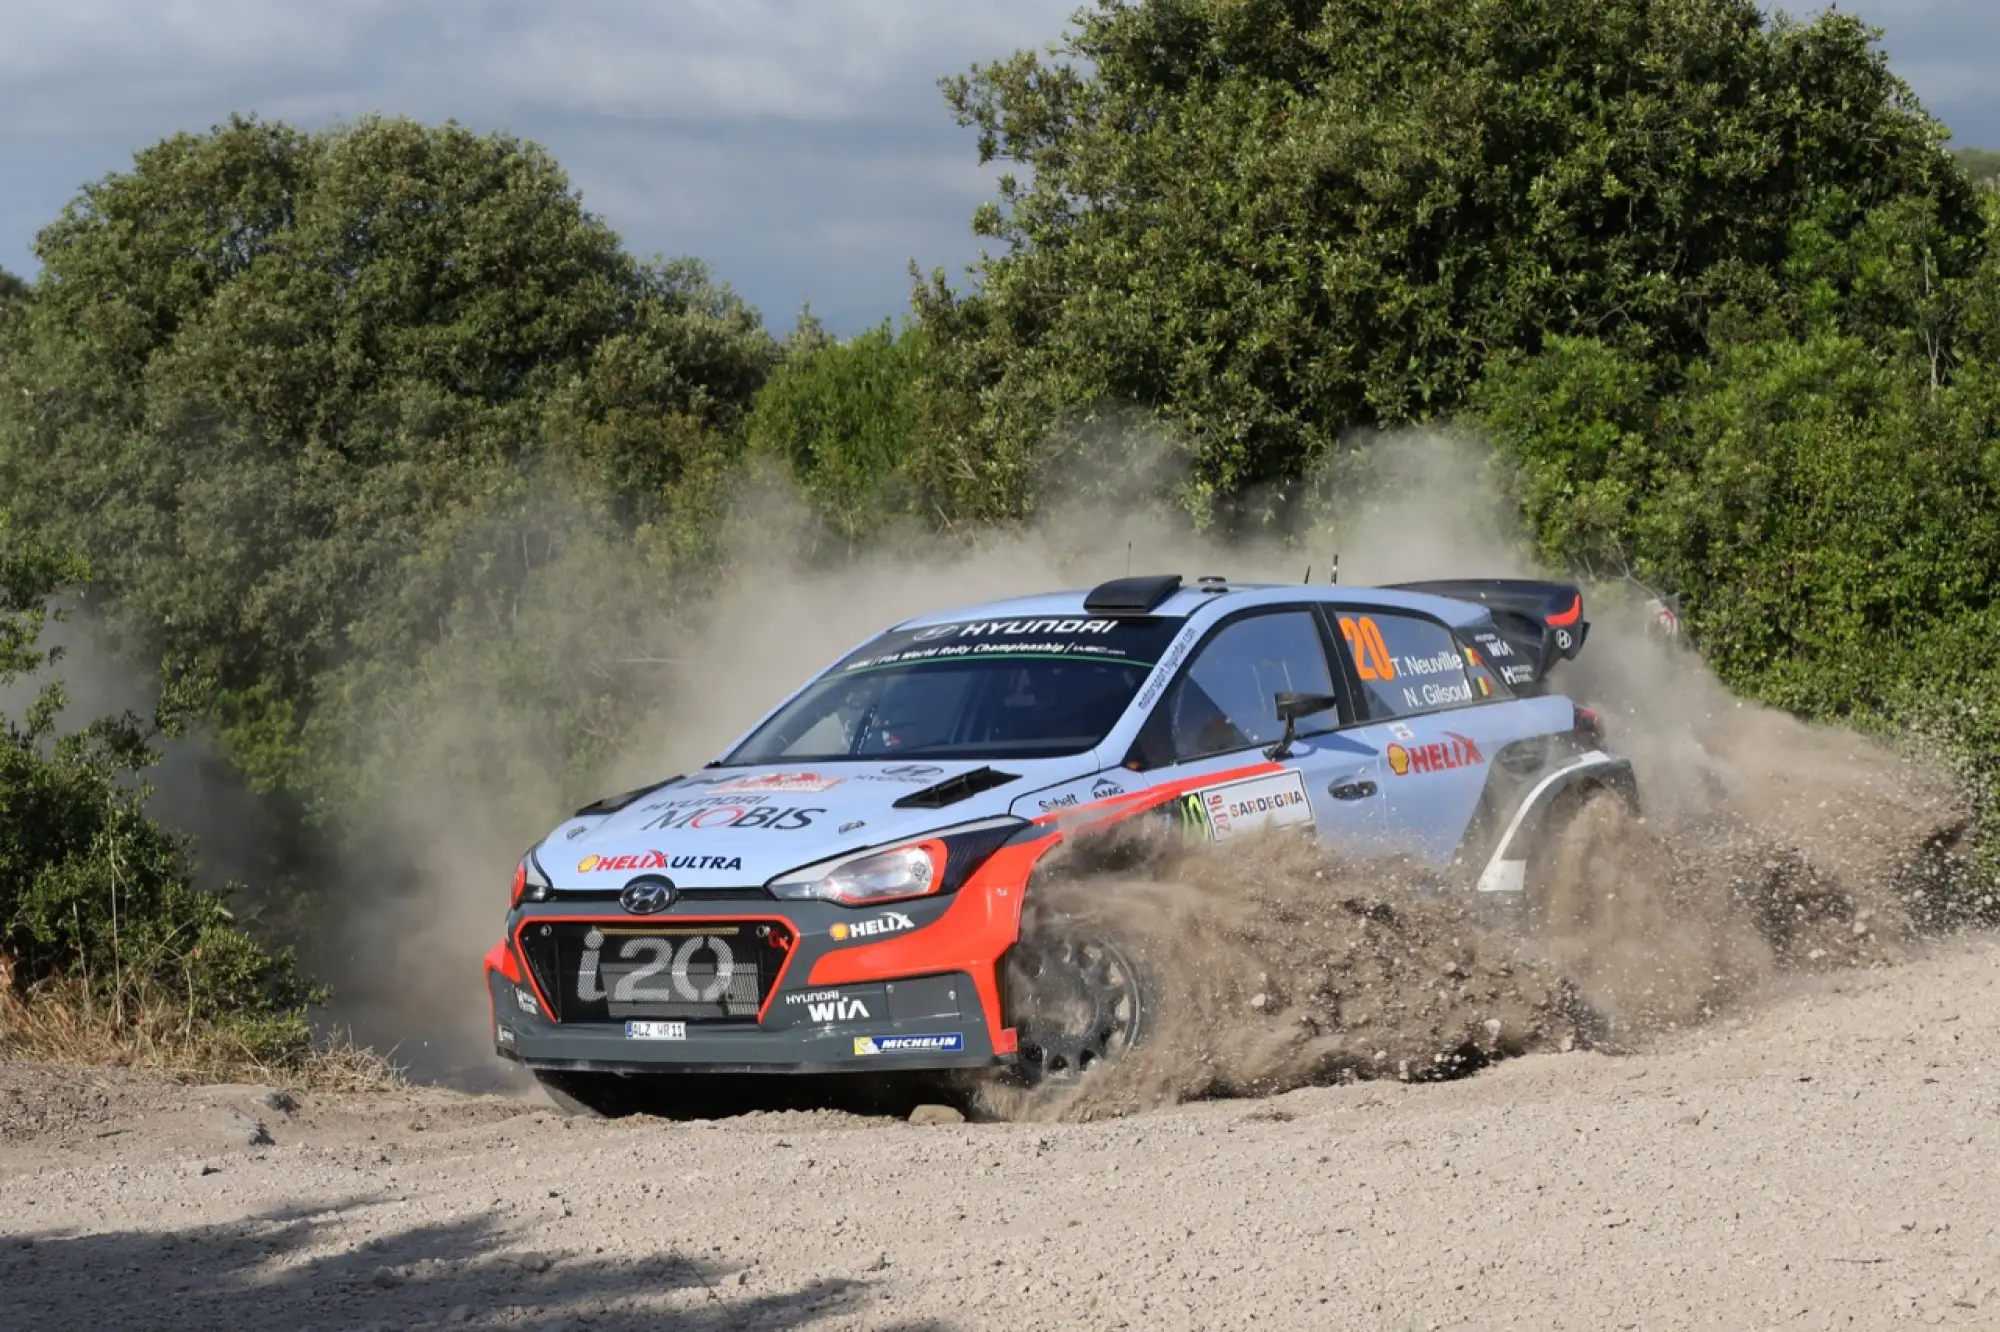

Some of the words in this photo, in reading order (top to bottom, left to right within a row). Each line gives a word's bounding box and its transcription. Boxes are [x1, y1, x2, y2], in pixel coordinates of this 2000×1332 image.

[959, 620, 1119, 637] HYUNDAI
[973, 642, 1065, 654] Championship
[1338, 616, 1395, 681] 20
[1390, 657, 1407, 676] T.
[1404, 650, 1463, 676] Neuville
[1402, 687, 1423, 708] N.
[1408, 731, 1485, 773] HELIX
[1229, 790, 1304, 818] SARDEGNA
[641, 805, 828, 831] MOBIS
[597, 850, 669, 871] HELIX
[670, 856, 742, 871] ULTRA
[850, 911, 915, 938] HELIX
[577, 926, 735, 1001] i20
[785, 989, 840, 1005] HYUNDAI
[807, 996, 871, 1023] WIA
[881, 1036, 957, 1049] MICHELIN
